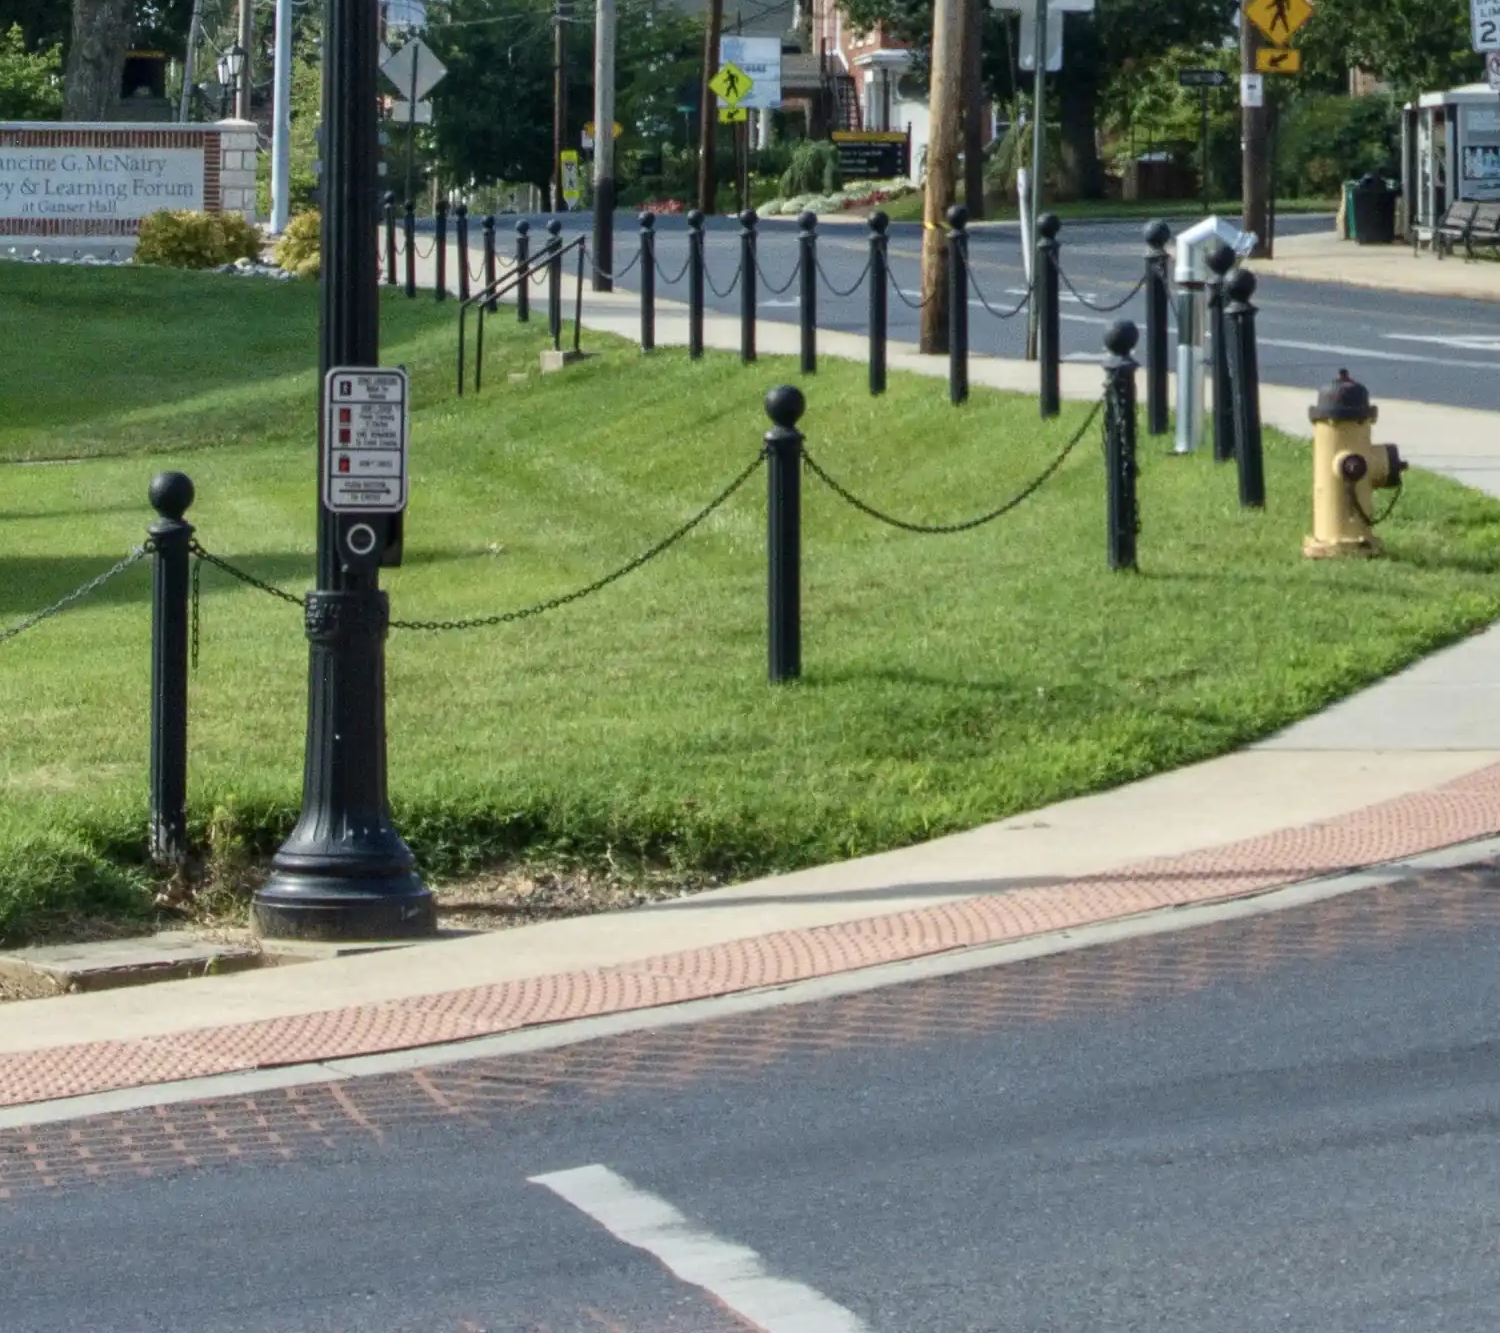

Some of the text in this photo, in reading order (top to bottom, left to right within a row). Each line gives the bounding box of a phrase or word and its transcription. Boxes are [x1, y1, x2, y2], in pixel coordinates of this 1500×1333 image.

[61, 154, 82, 173] G.
[86, 154, 167, 177] McNairy
[19, 177, 40, 195] &
[44, 178, 128, 200] Learning
[133, 178, 194, 196] Forum
[21, 199, 117, 213] at Ganser Hall
